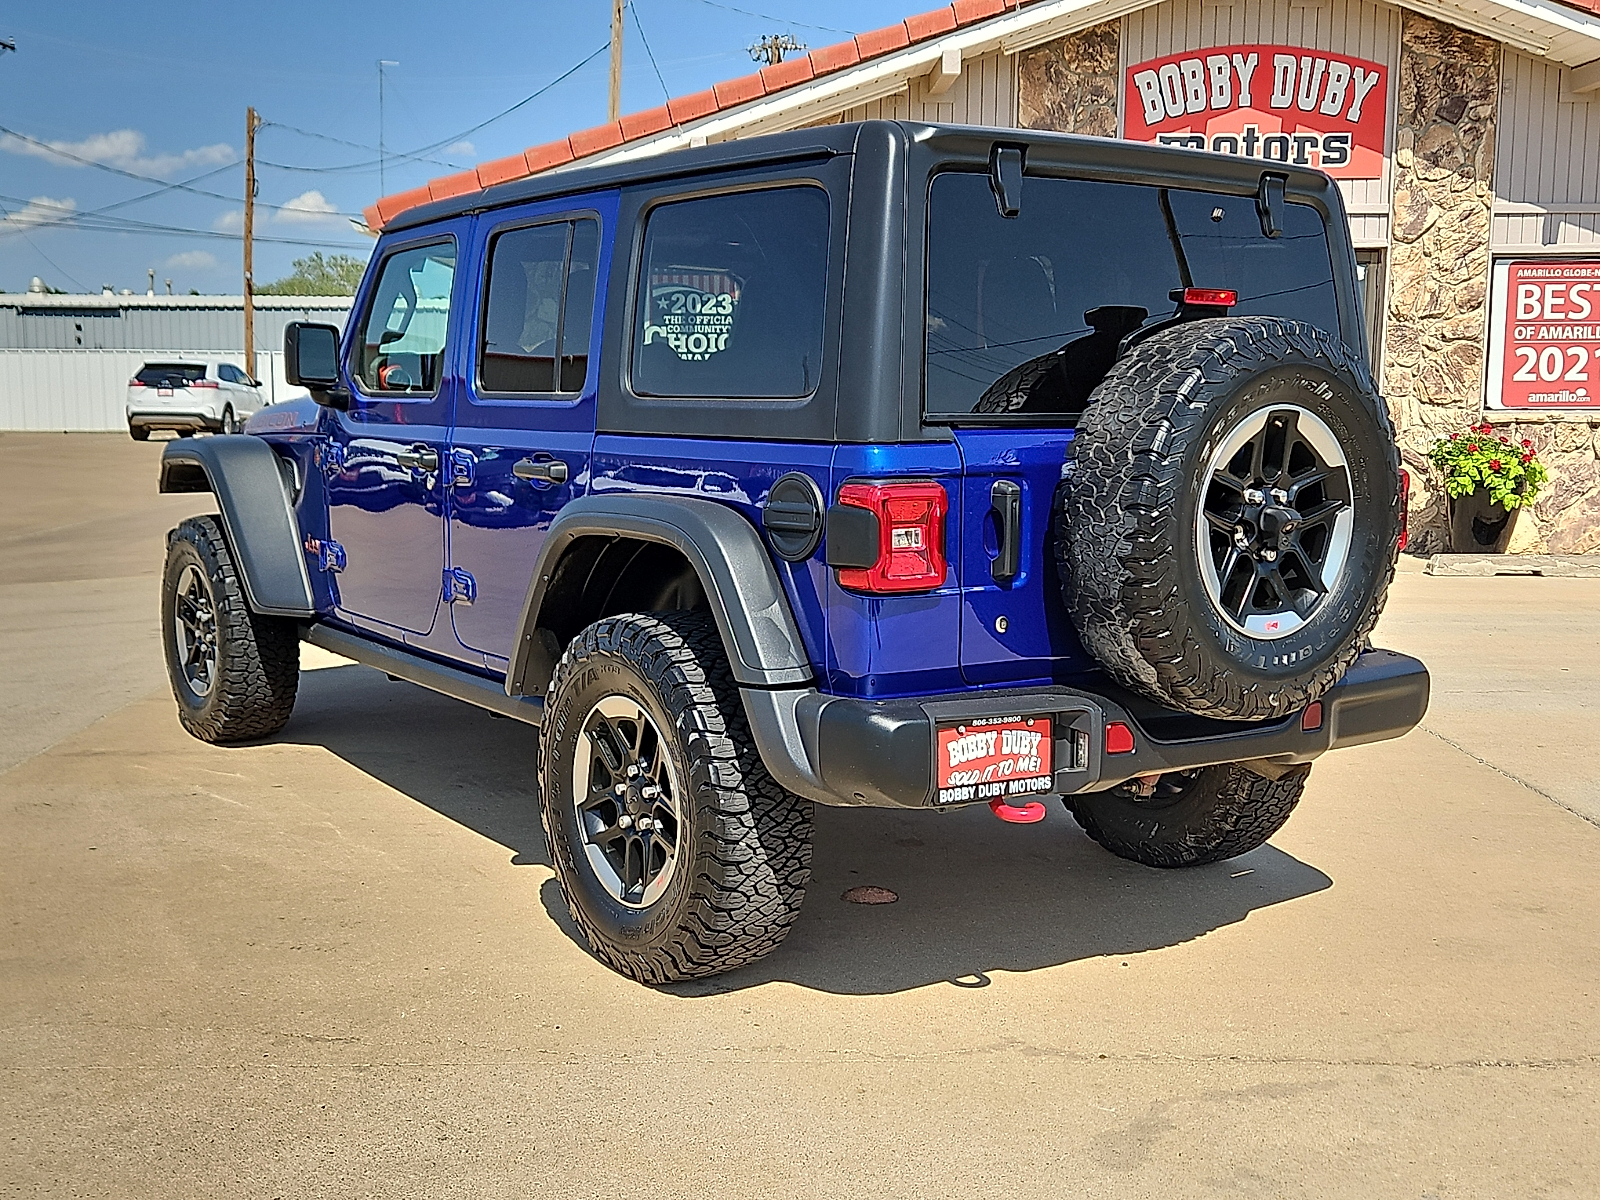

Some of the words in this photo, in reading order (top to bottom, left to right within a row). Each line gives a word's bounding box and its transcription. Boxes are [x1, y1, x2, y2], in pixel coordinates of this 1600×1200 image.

[1133, 52, 1259, 126] BOBBY
[1270, 53, 1380, 124] DUBY
[1517, 268, 1562, 277] AMARILLO
[671, 293, 733, 314] 2023
[663, 315, 686, 325] THE
[1514, 326, 1536, 340] OF
[972, 715, 1022, 726] 806-352-9800
[946, 730, 998, 768] BOBBY
[1001, 730, 1042, 757] DUBY
[947, 769, 980, 786] SOLD
[981, 763, 998, 783] IT
[997, 758, 1014, 778] TO
[1016, 756, 1041, 773] ME!
[939, 788, 976, 803] BOBBY
[978, 782, 1007, 798] DUBY
[1009, 776, 1052, 794] MOTORS
